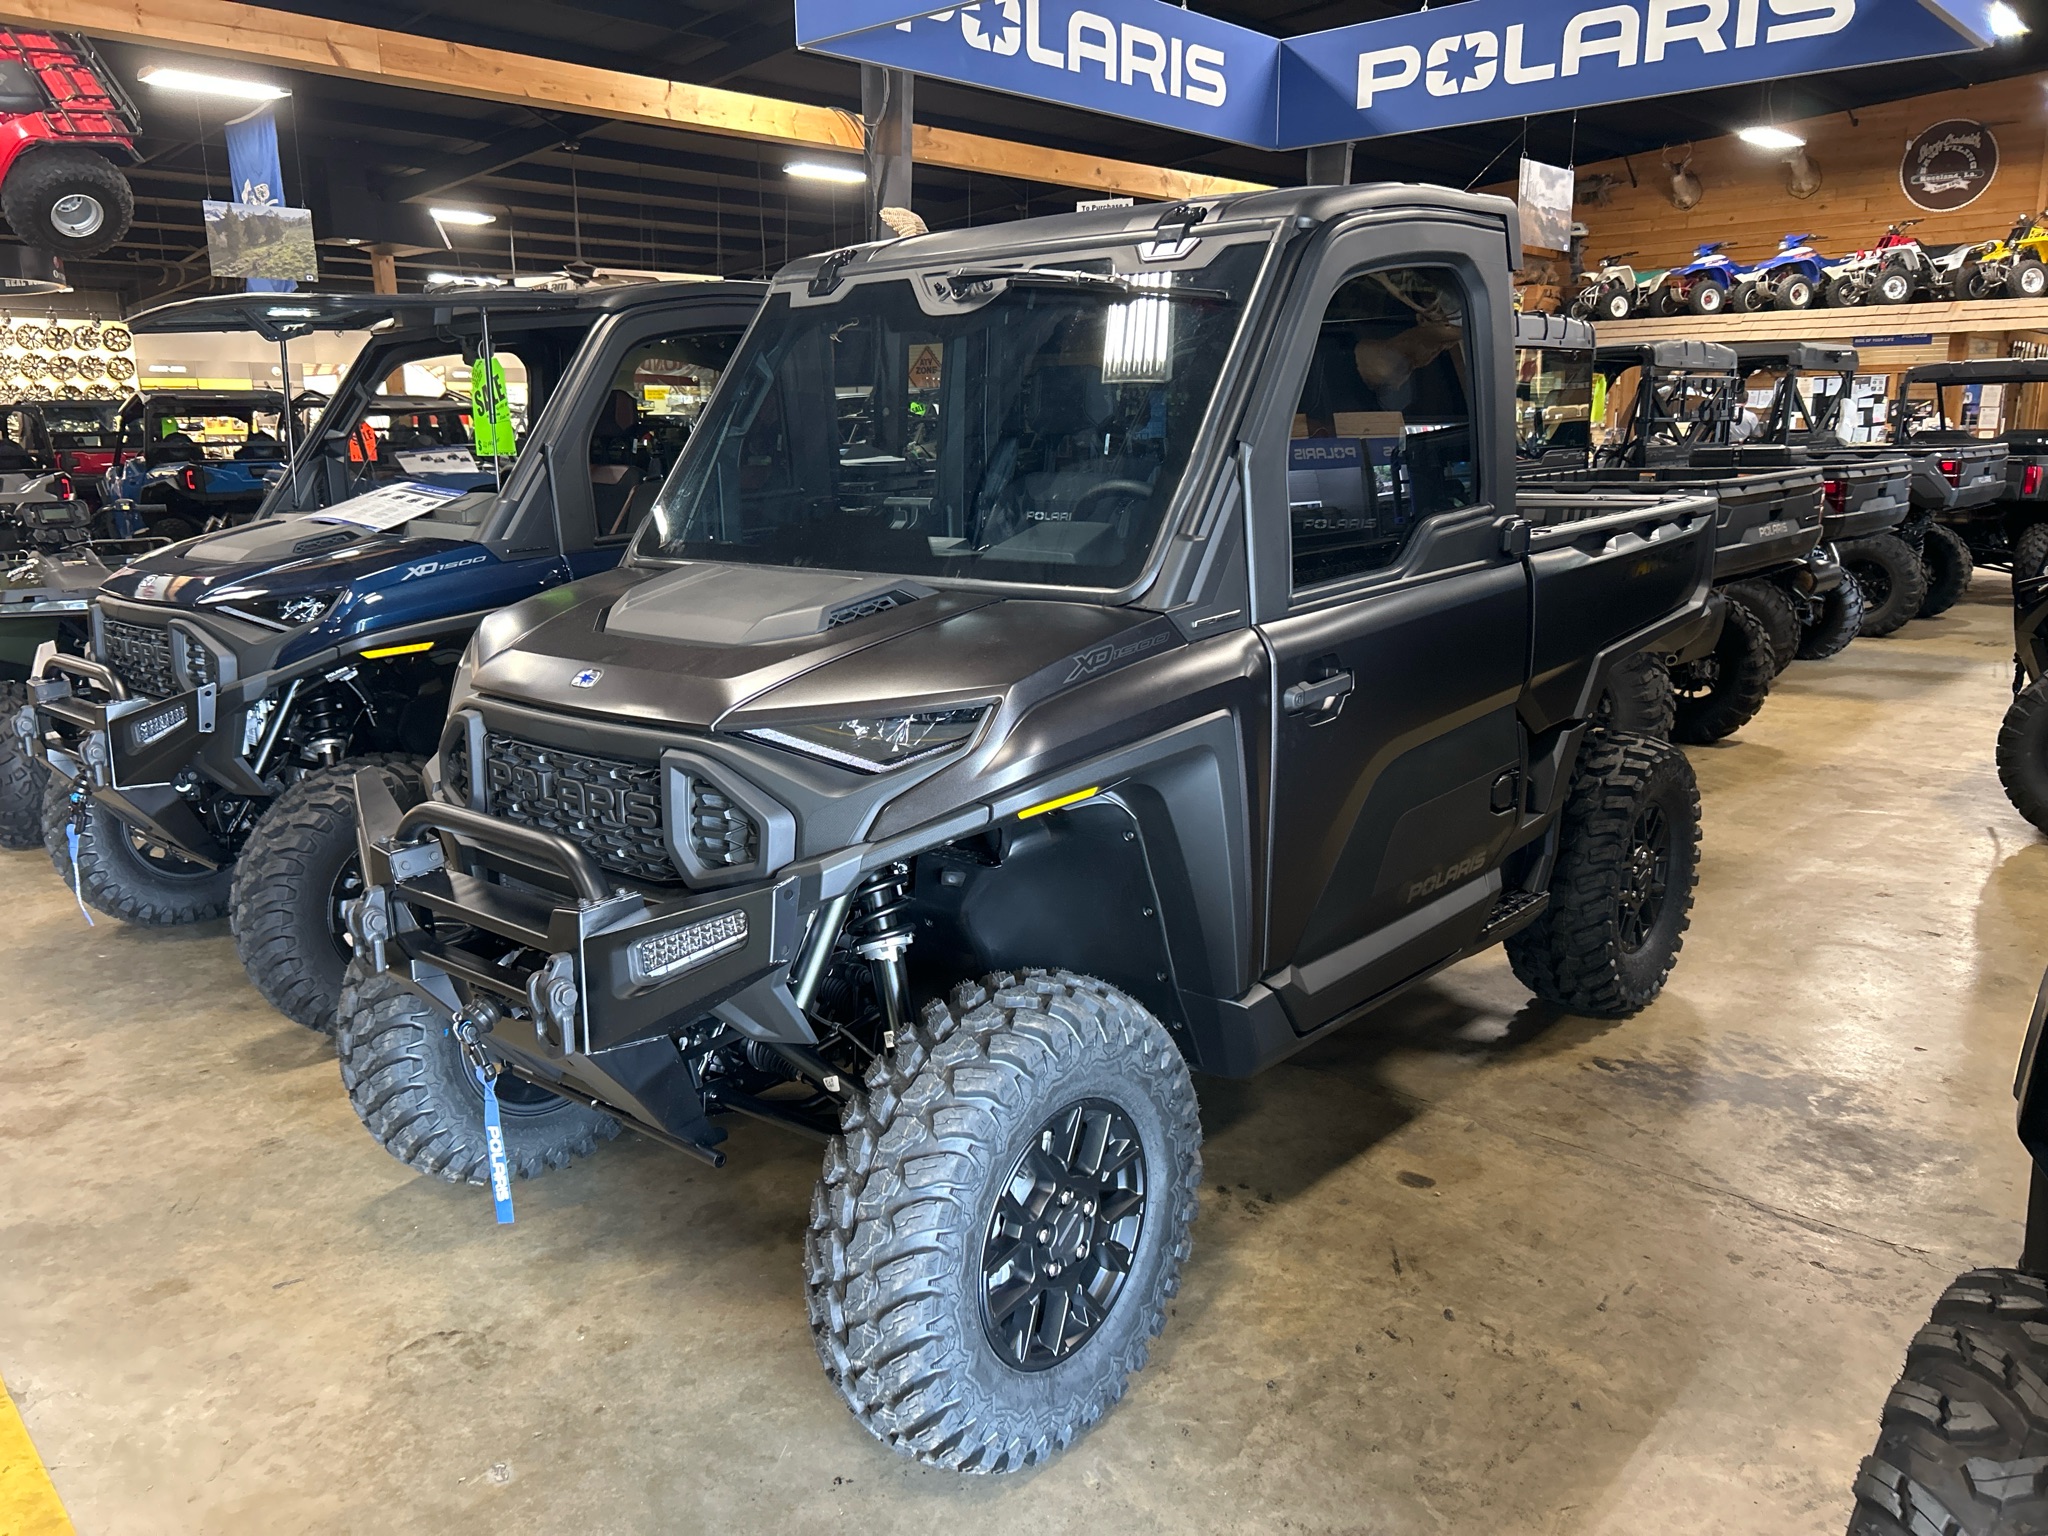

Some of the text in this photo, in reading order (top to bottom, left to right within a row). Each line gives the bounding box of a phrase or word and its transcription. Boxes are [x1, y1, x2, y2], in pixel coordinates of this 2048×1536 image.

[896, 0, 1227, 108] OLARIS
[1357, 0, 1856, 110] POLARIS
[916, 366, 938, 375] ZONE
[1026, 511, 1072, 521] POLARI
[1303, 518, 1377, 529] POLARIS
[1759, 522, 1788, 538] POLARIS
[488, 757, 662, 829] POLARIS
[1407, 850, 1487, 904] POLARIS
[487, 1125, 510, 1202] POLARIS
